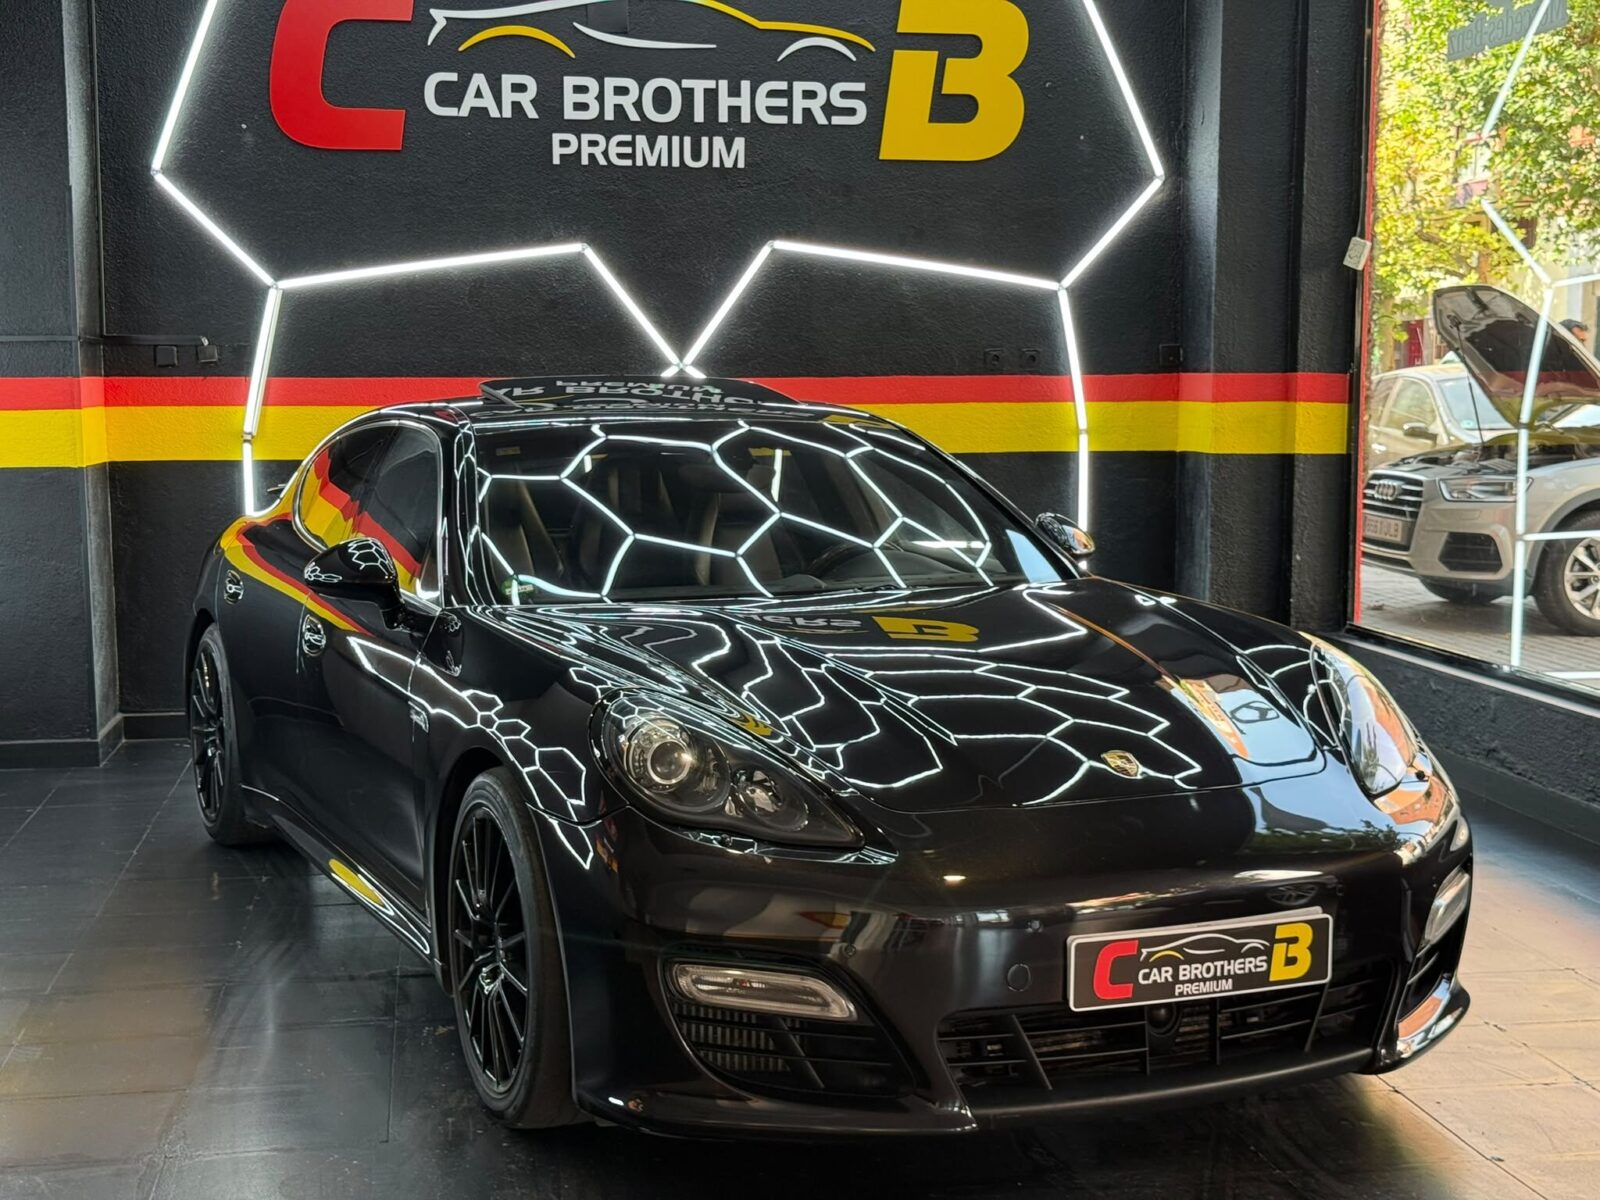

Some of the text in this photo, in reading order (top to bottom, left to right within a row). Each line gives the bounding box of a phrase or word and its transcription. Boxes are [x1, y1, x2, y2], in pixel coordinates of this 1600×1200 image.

[269, 0, 414, 151] C
[424, 72, 867, 126] CAR BROTHERS
[879, 0, 1029, 162] B
[551, 132, 746, 169] PREMIUM
[1093, 939, 1139, 1000] C
[1138, 955, 1268, 985] CAR BROTHERS
[1268, 922, 1313, 982] B
[1174, 978, 1233, 997] PREMIUM
